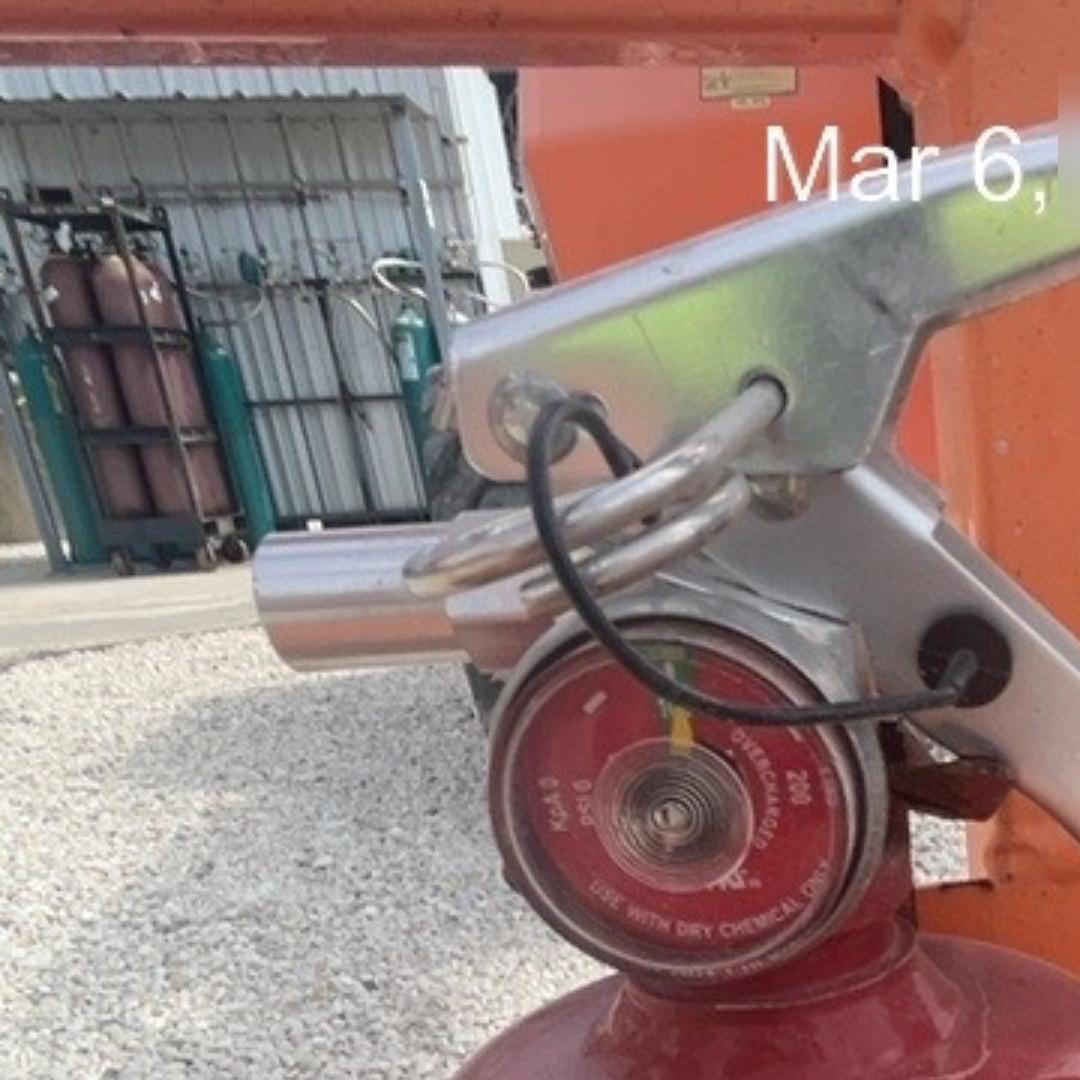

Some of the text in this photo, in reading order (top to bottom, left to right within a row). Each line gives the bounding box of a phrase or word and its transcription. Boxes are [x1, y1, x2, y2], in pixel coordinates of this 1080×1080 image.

[730, 727, 781, 851] OVERCHARGED
[626, 904, 671, 934] WITH
[676, 914, 713, 940] DRY
[721, 896, 802, 940] CHEMICAL
